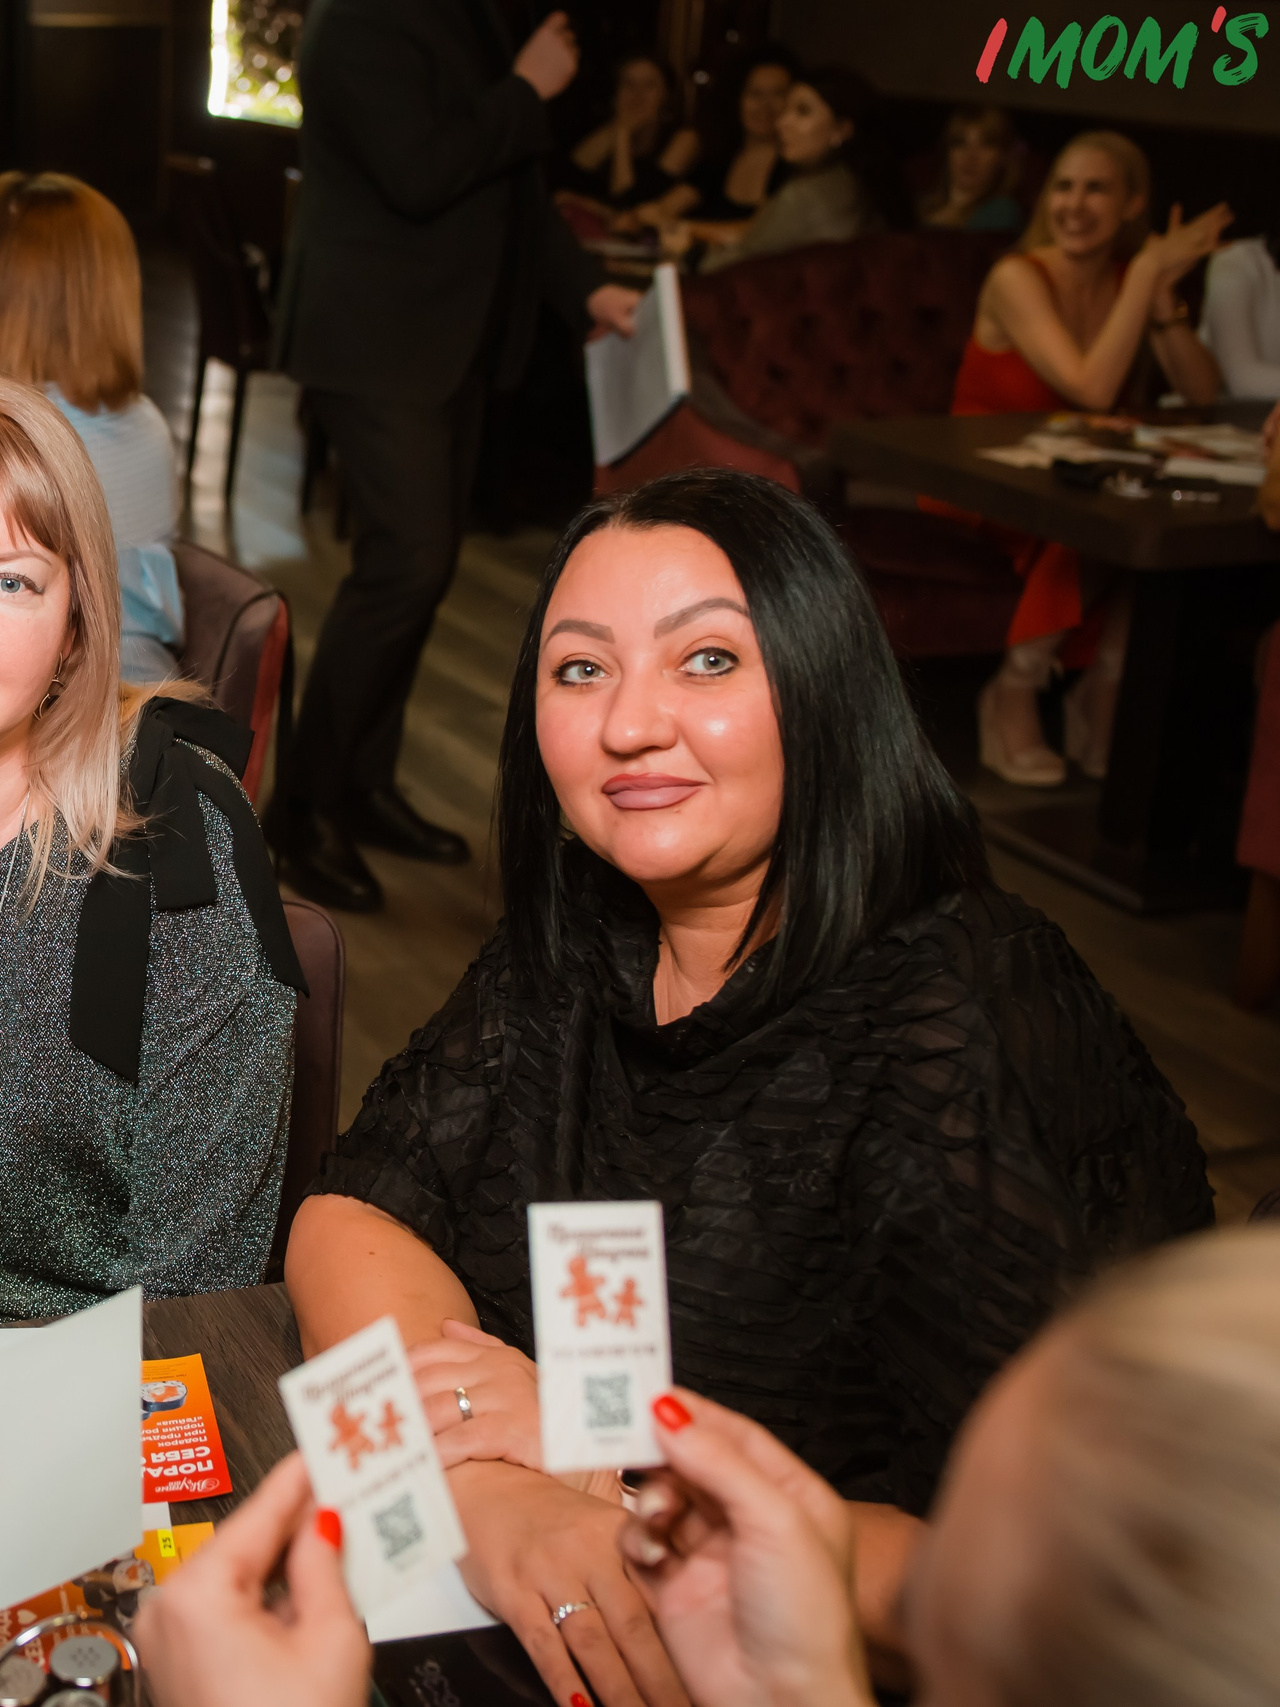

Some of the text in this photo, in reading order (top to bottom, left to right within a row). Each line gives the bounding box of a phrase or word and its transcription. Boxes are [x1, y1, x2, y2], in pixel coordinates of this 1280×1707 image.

[163, 1422, 204, 1432] порция
[184, 1429, 206, 1437] при
[158, 1436, 207, 1447] Подарок
[151, 1446, 211, 1463] СЕБЯ
[162, 1537, 172, 1549] 25
